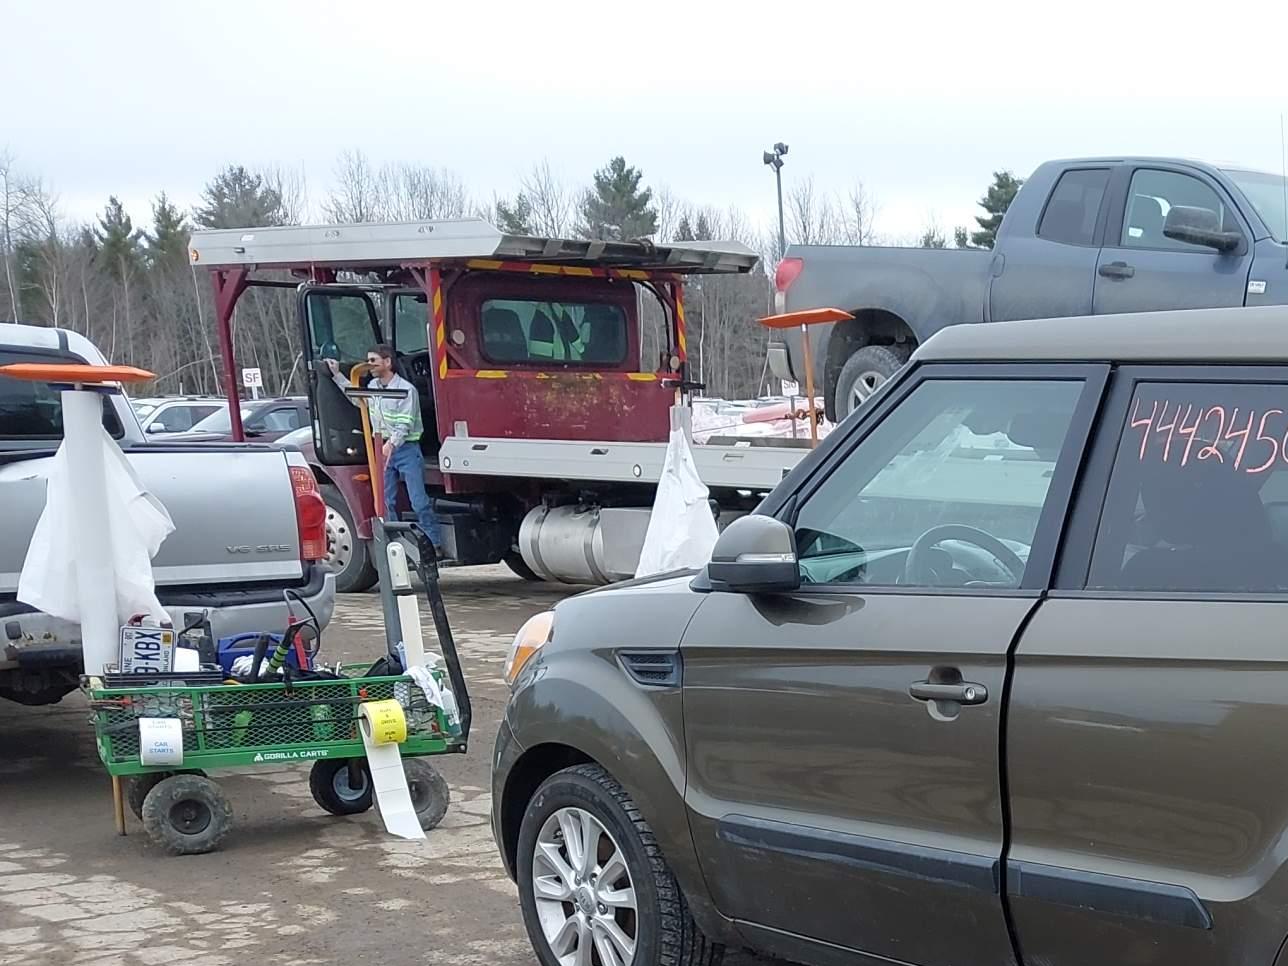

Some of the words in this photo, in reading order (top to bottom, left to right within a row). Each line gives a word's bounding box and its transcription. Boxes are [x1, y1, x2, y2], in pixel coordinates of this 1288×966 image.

[244, 372, 260, 384] SF
[263, 751, 299, 760] GORILLA
[300, 750, 328, 758] CARTS
